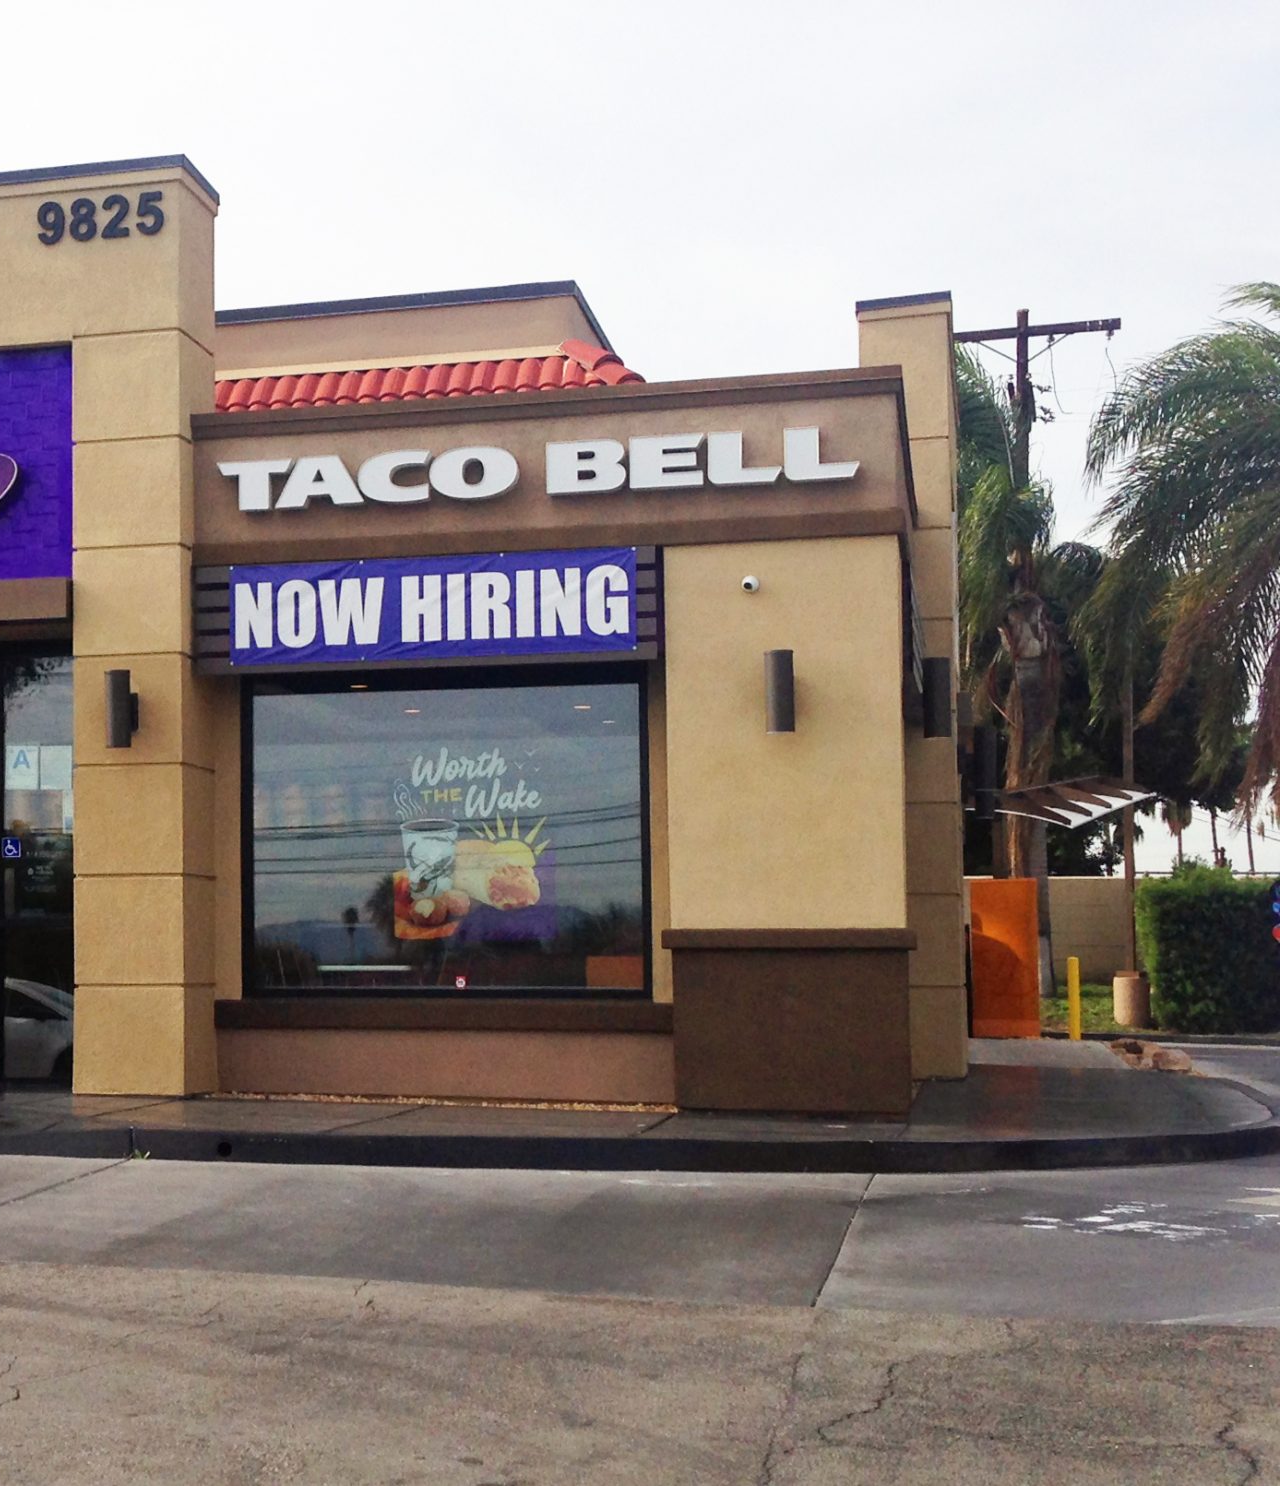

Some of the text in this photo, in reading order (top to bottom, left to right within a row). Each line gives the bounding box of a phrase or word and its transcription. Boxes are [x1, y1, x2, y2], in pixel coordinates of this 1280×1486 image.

[37, 191, 165, 245] 9825
[217, 426, 860, 512] TACO BELL
[235, 564, 629, 649] NOW HIRING
[13, 749, 30, 769] A
[412, 747, 507, 787] Worth
[421, 778, 542, 818] THE Wake
